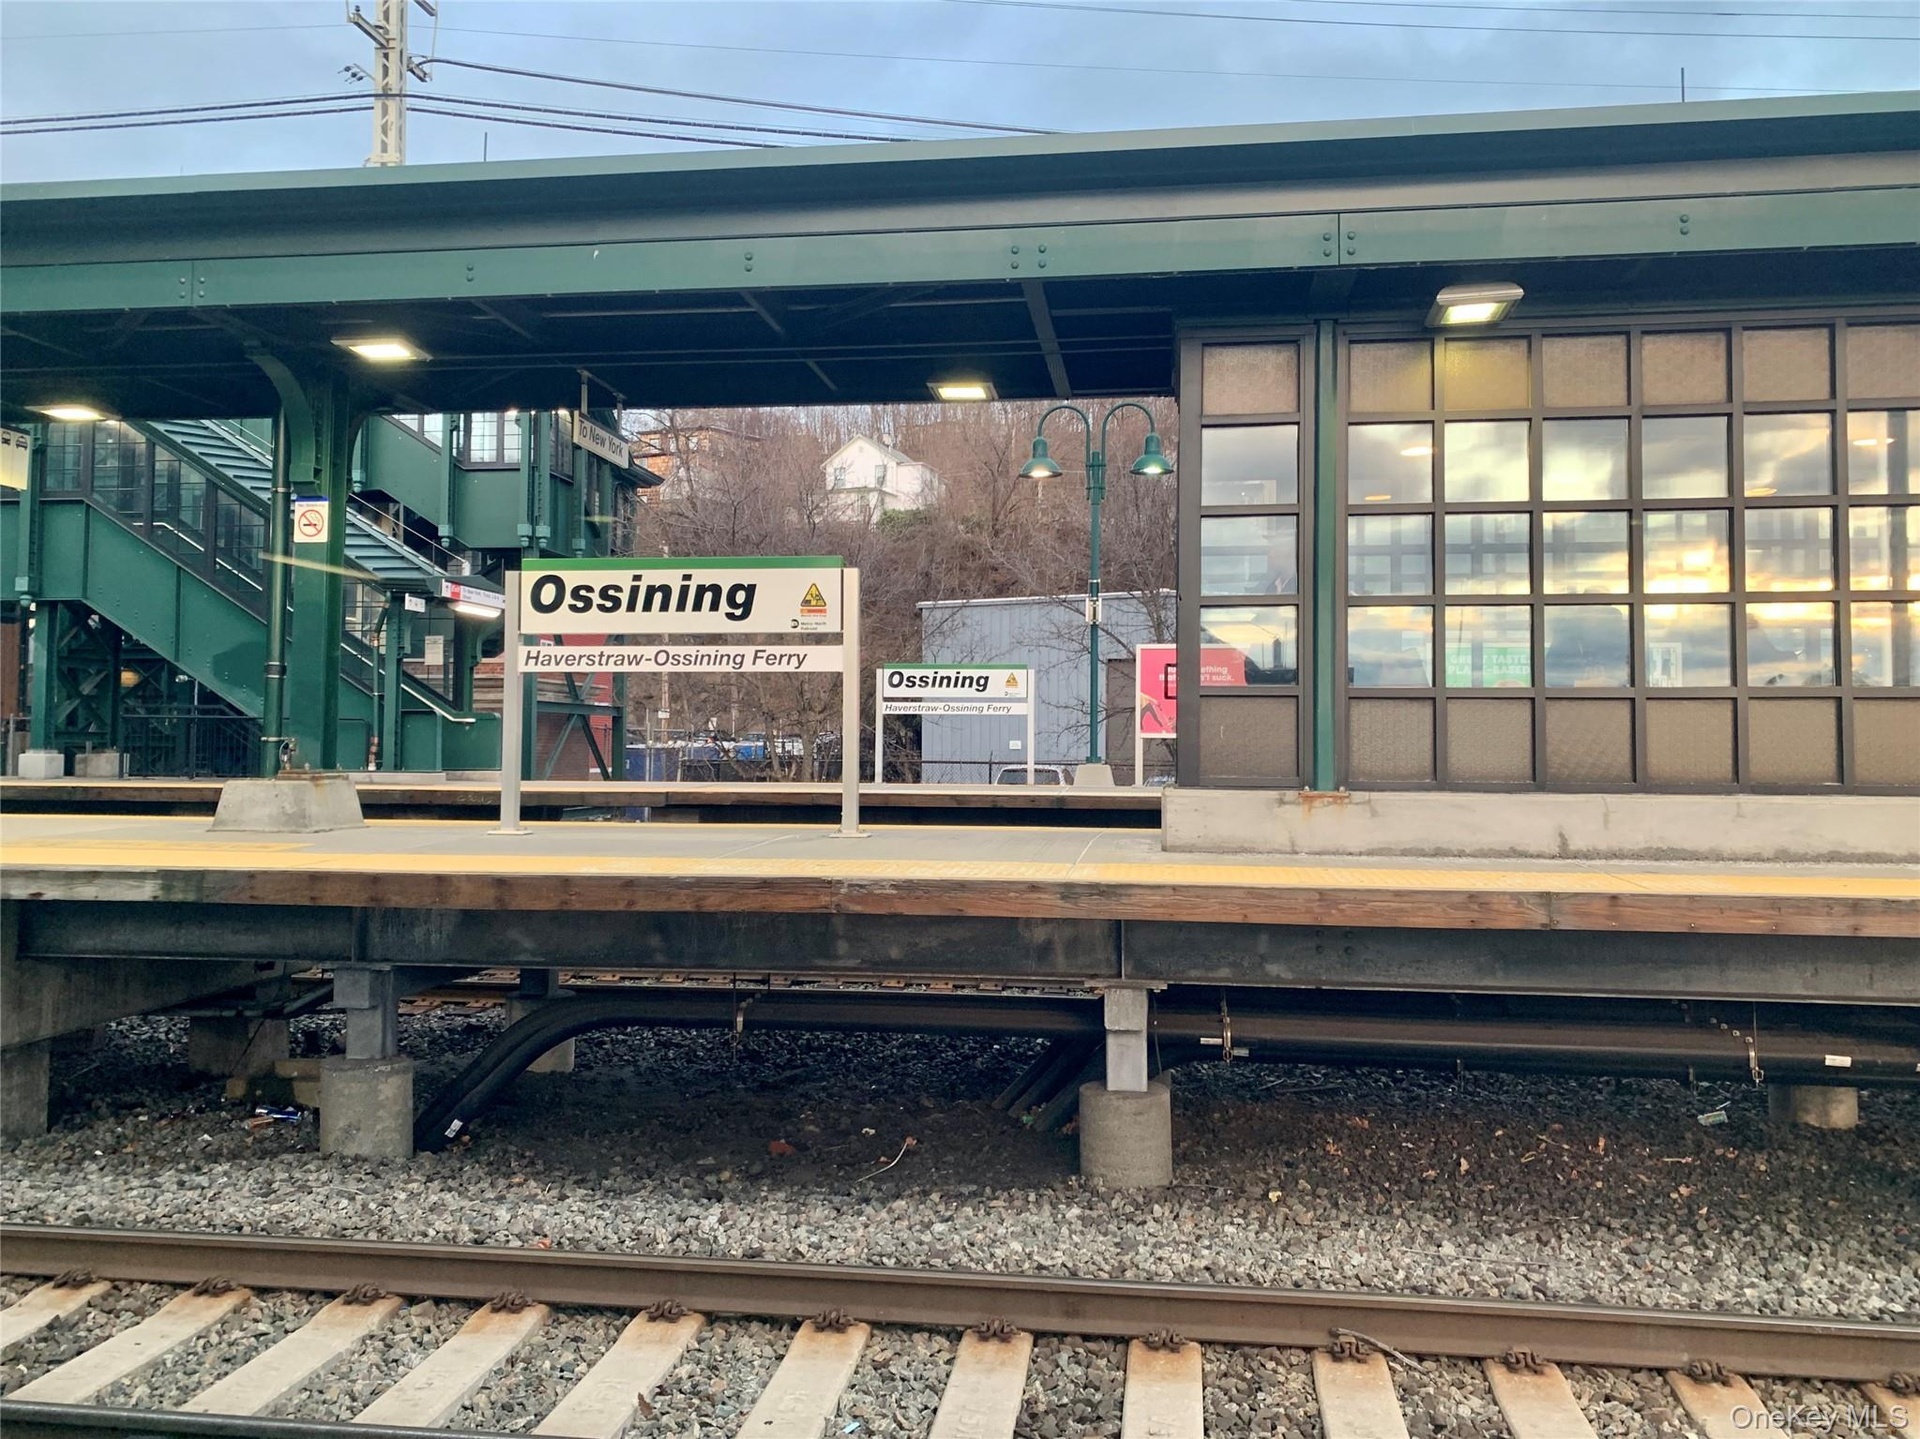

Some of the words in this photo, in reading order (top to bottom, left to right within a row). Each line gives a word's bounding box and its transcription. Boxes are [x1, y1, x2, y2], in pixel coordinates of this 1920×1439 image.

[579, 419, 588, 438] To
[589, 425, 606, 448] New
[608, 435, 624, 458] York
[530, 574, 757, 621] Ossining
[524, 649, 747, 669] Haverstraw-Ossining
[751, 648, 807, 669] Ferry
[888, 671, 990, 692] Ossining
[884, 703, 985, 714] Haverstraw-Ossining
[987, 703, 1012, 714] Ferry
